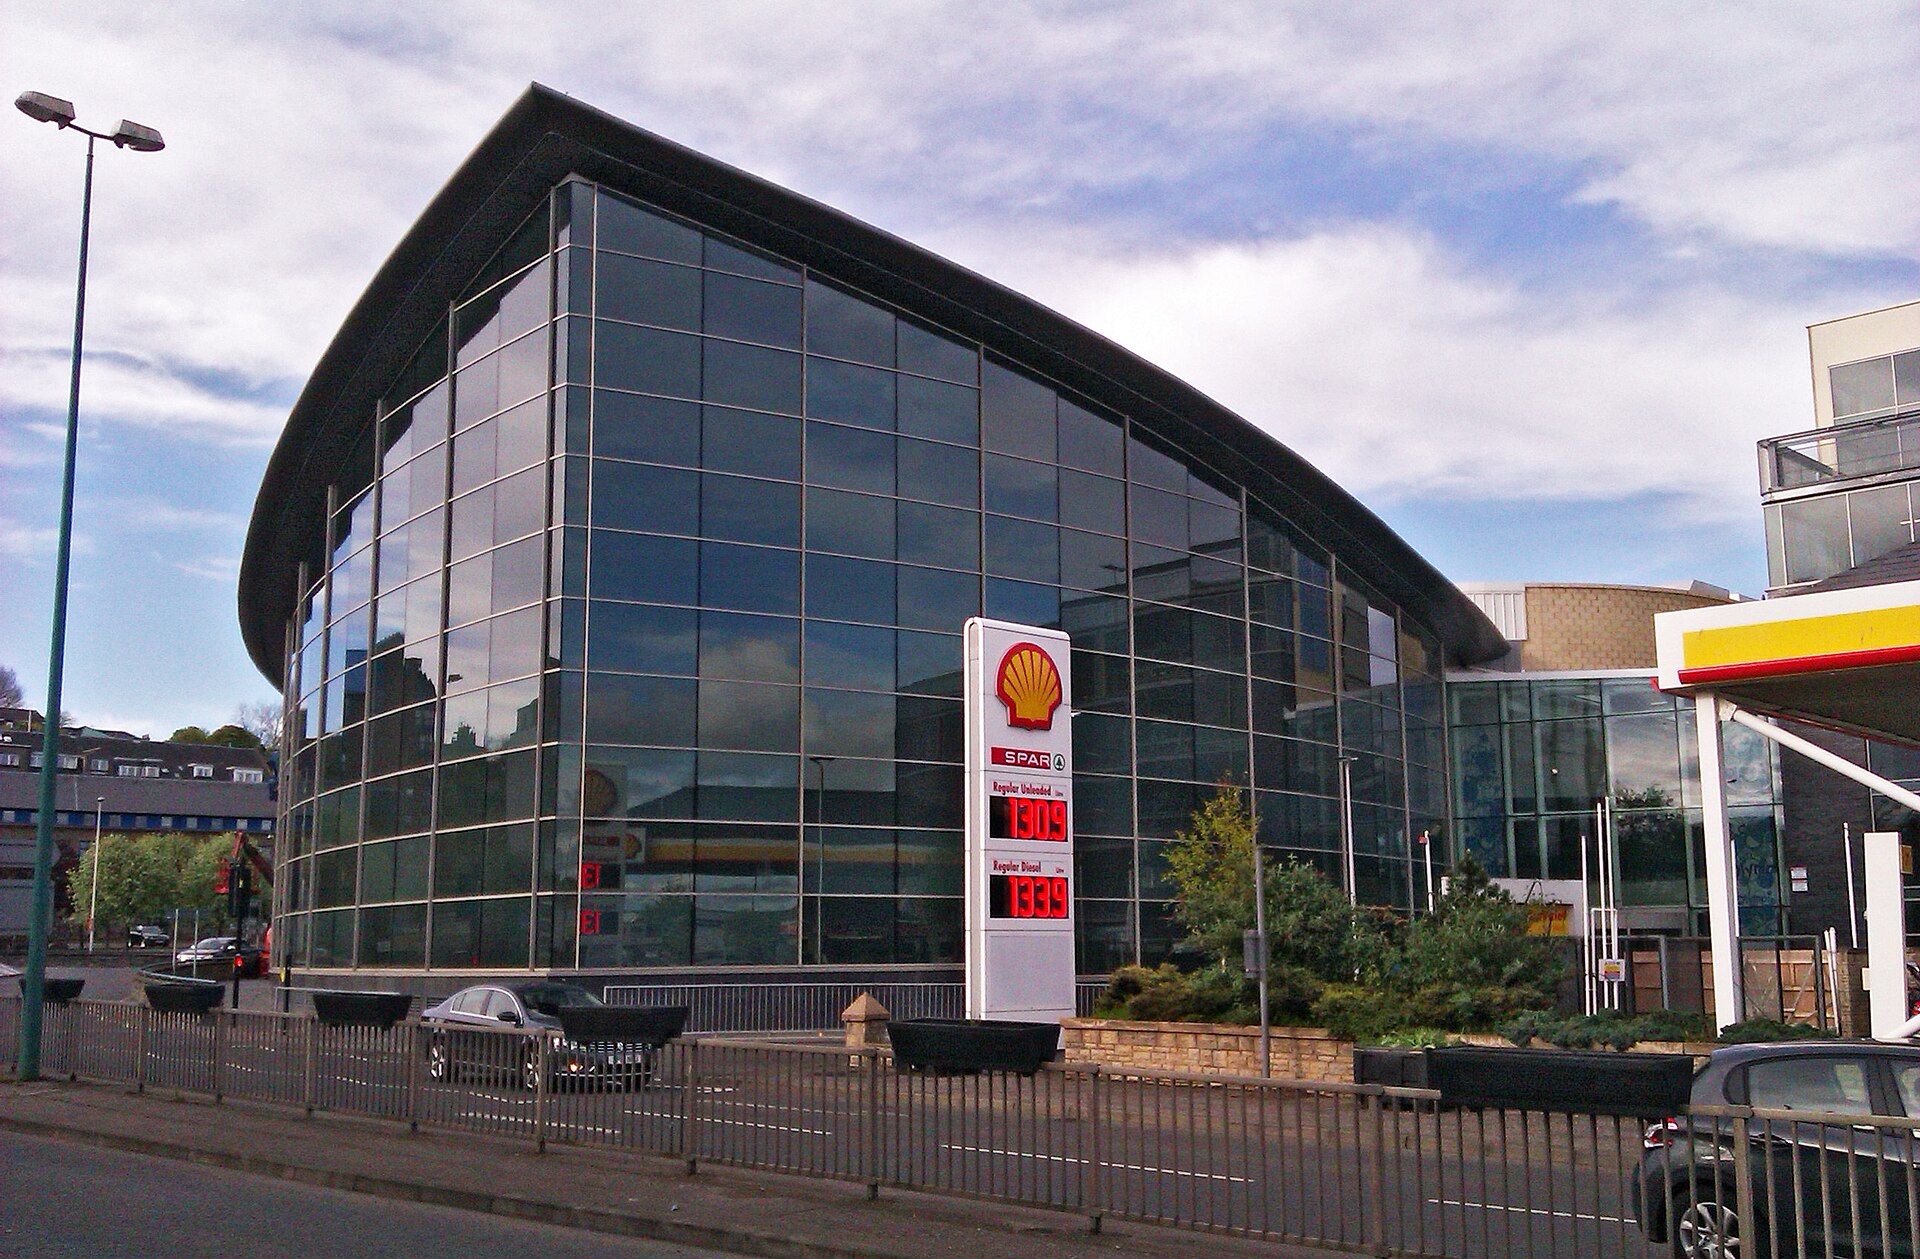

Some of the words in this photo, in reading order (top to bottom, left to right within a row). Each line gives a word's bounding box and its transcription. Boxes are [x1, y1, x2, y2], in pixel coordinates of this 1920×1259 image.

[1005, 751, 1050, 767] SPAR
[993, 781, 1019, 795] Regular
[1021, 783, 1051, 796] Unleaded
[993, 860, 1019, 874] Regular
[1021, 861, 1041, 873] Diesel
